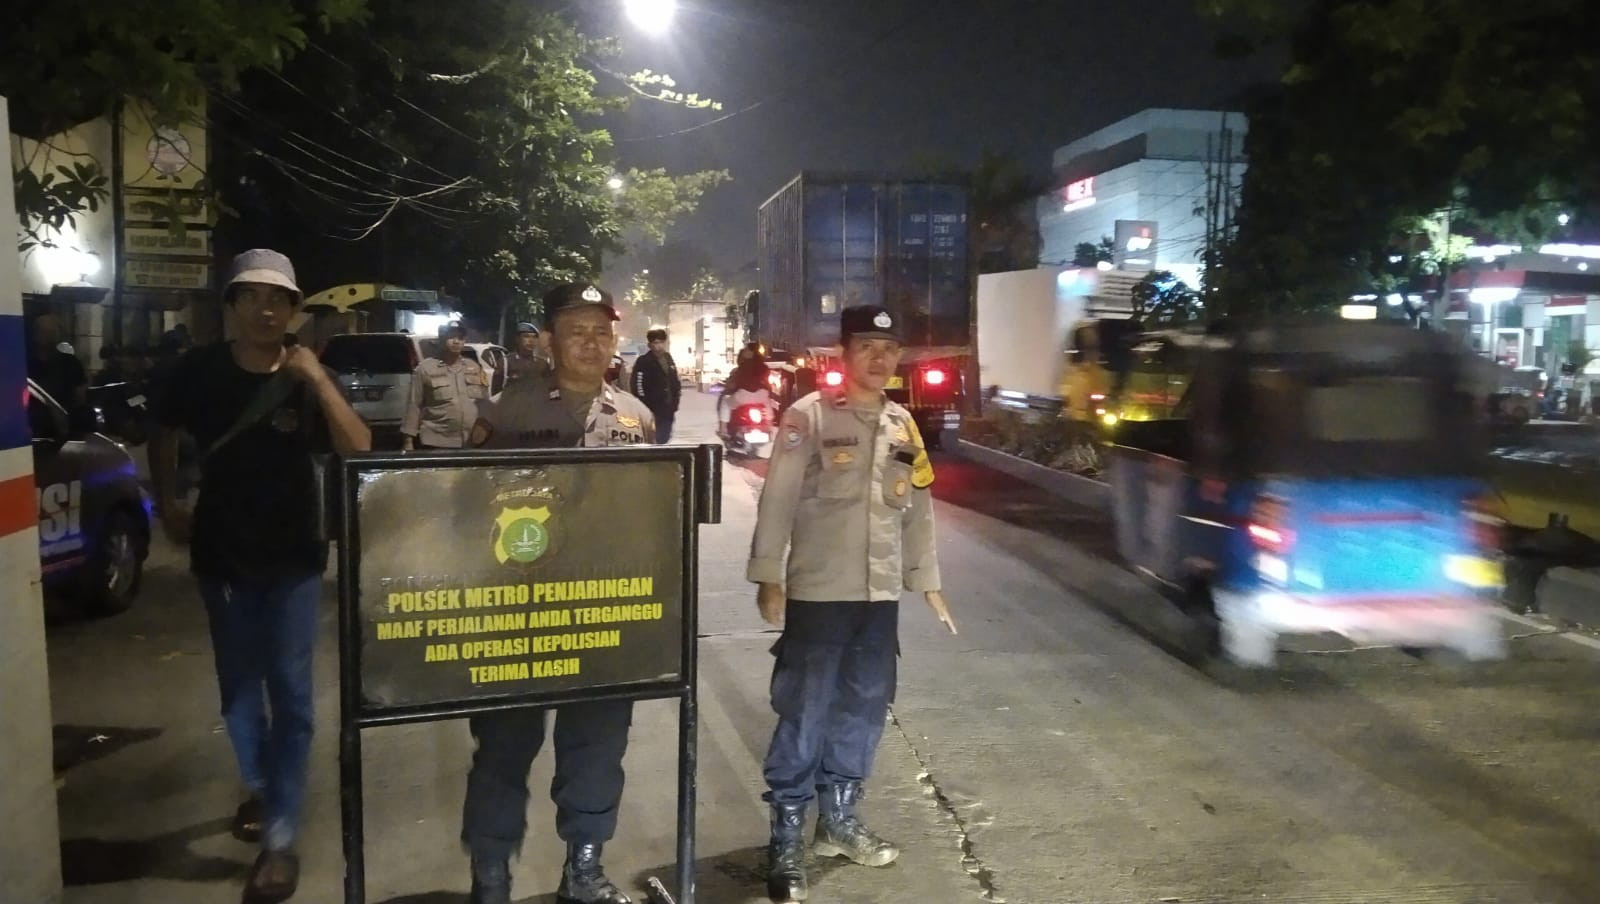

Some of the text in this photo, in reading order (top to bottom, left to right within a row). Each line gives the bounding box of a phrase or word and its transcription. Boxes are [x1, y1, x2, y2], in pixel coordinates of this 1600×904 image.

[388, 577, 653, 615] POLSEK METRO PENJARINGAN
[377, 603, 663, 640] MAAF PERJALANAN ANDA TERGANGGU
[425, 630, 621, 662] ADA OPERASI KEPOLISIAN
[470, 657, 580, 684] TERIMA KASIH
